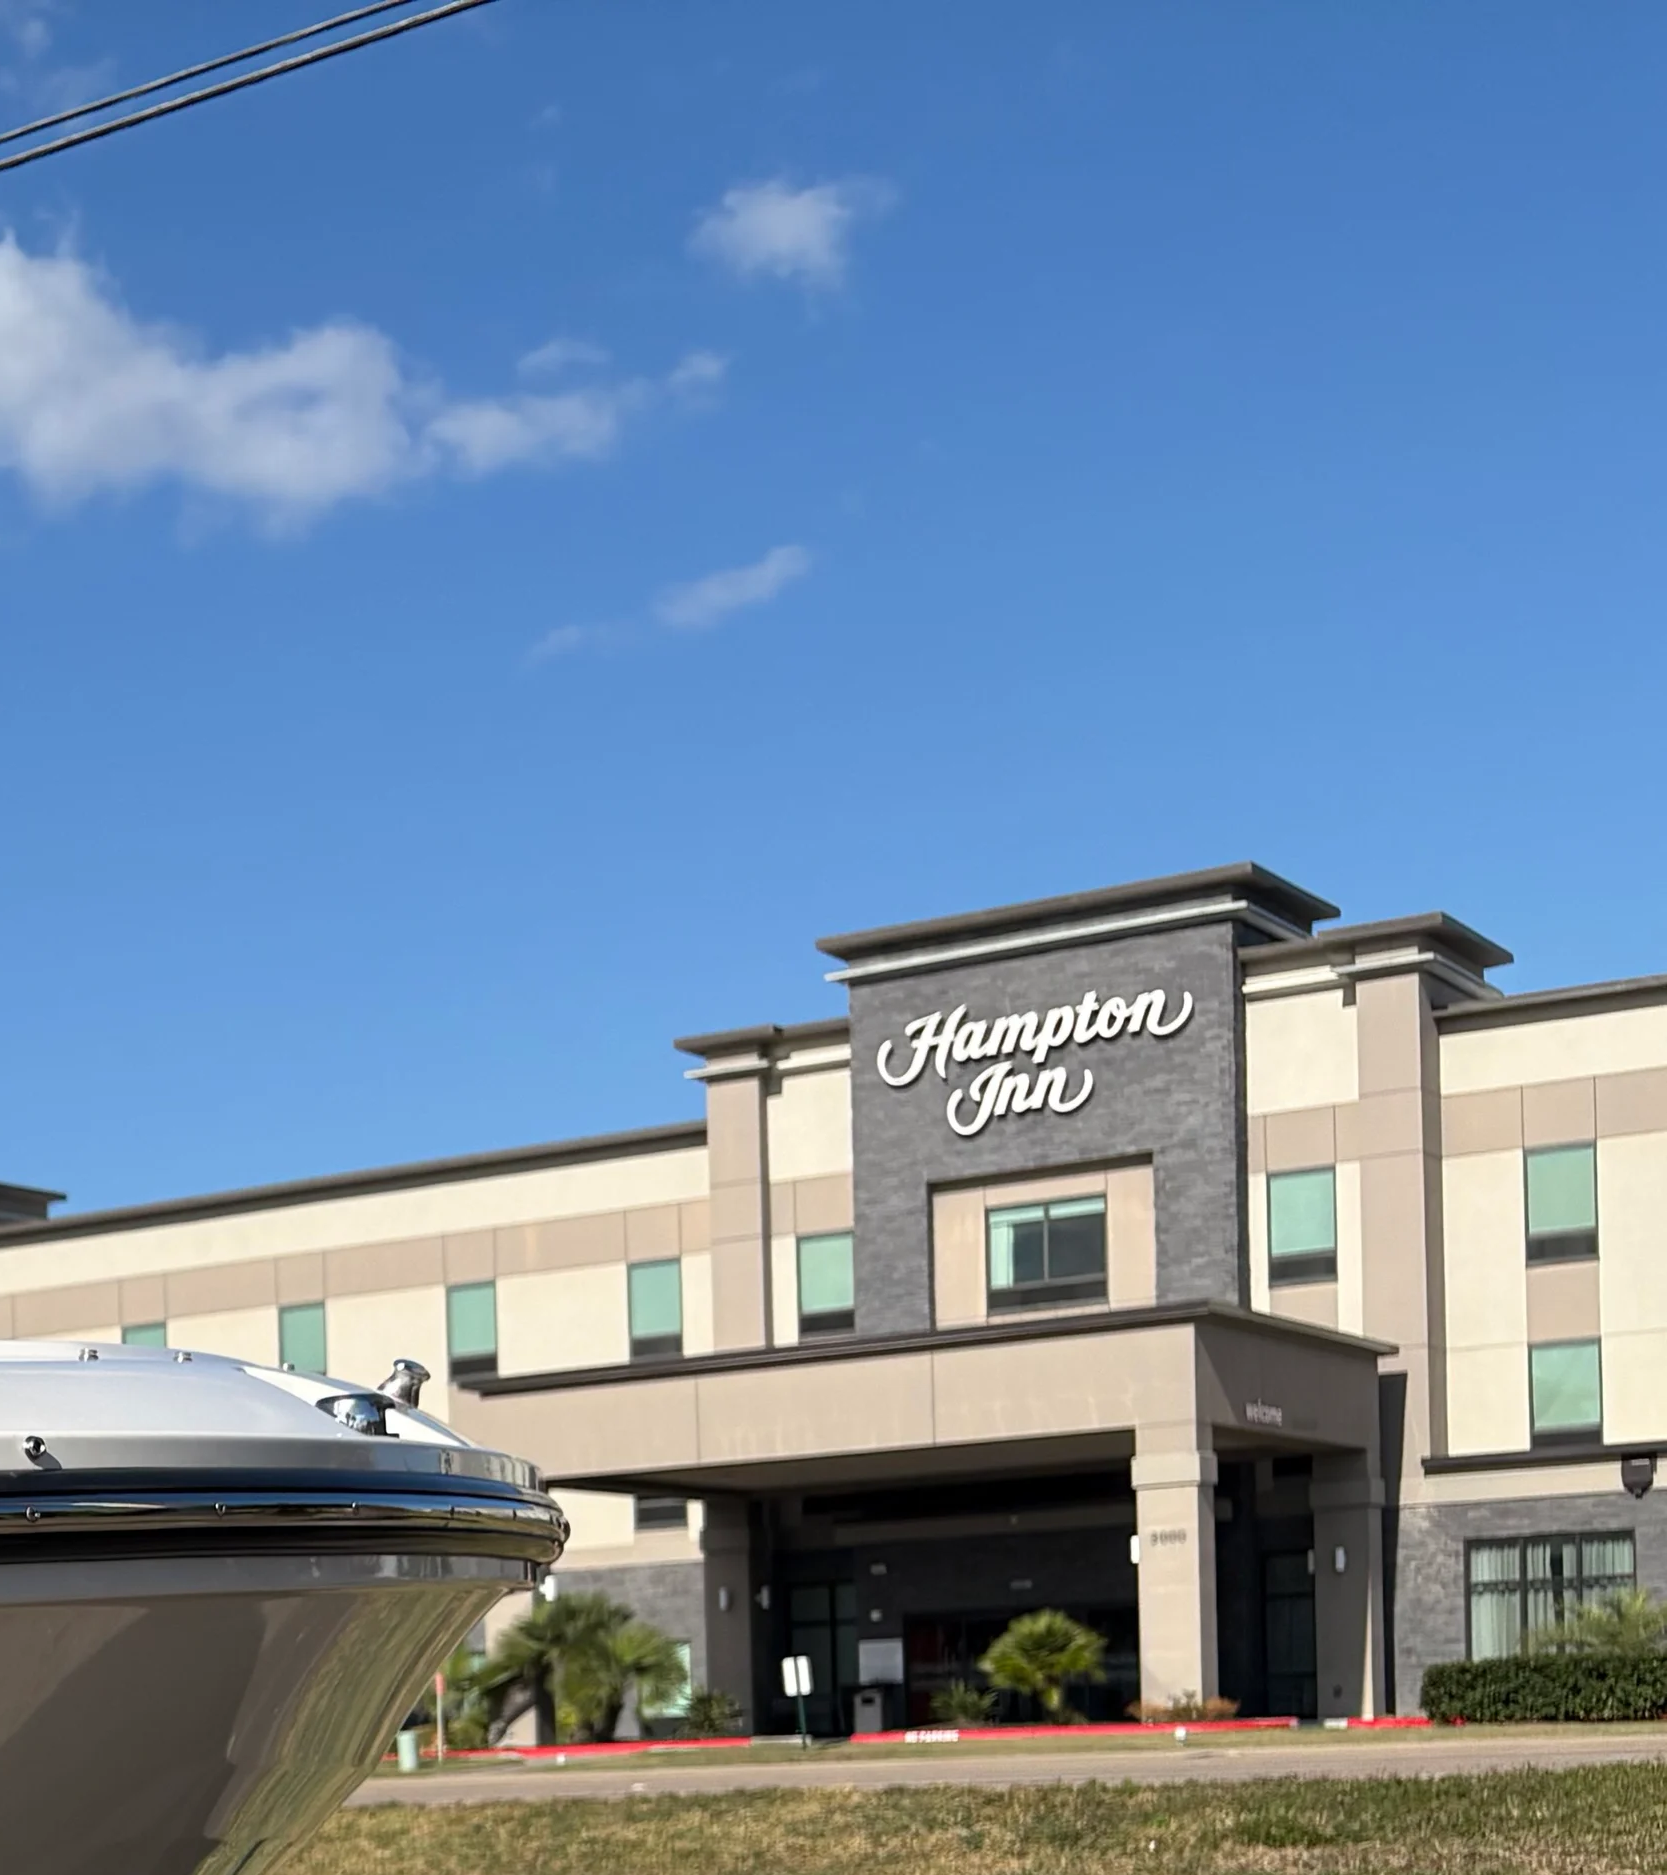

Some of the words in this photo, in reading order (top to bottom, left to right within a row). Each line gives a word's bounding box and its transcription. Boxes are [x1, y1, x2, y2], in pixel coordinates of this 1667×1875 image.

[876, 989, 1193, 1087] Hampton
[946, 1060, 1094, 1136] Inn
[1245, 1397, 1283, 1428] welcome
